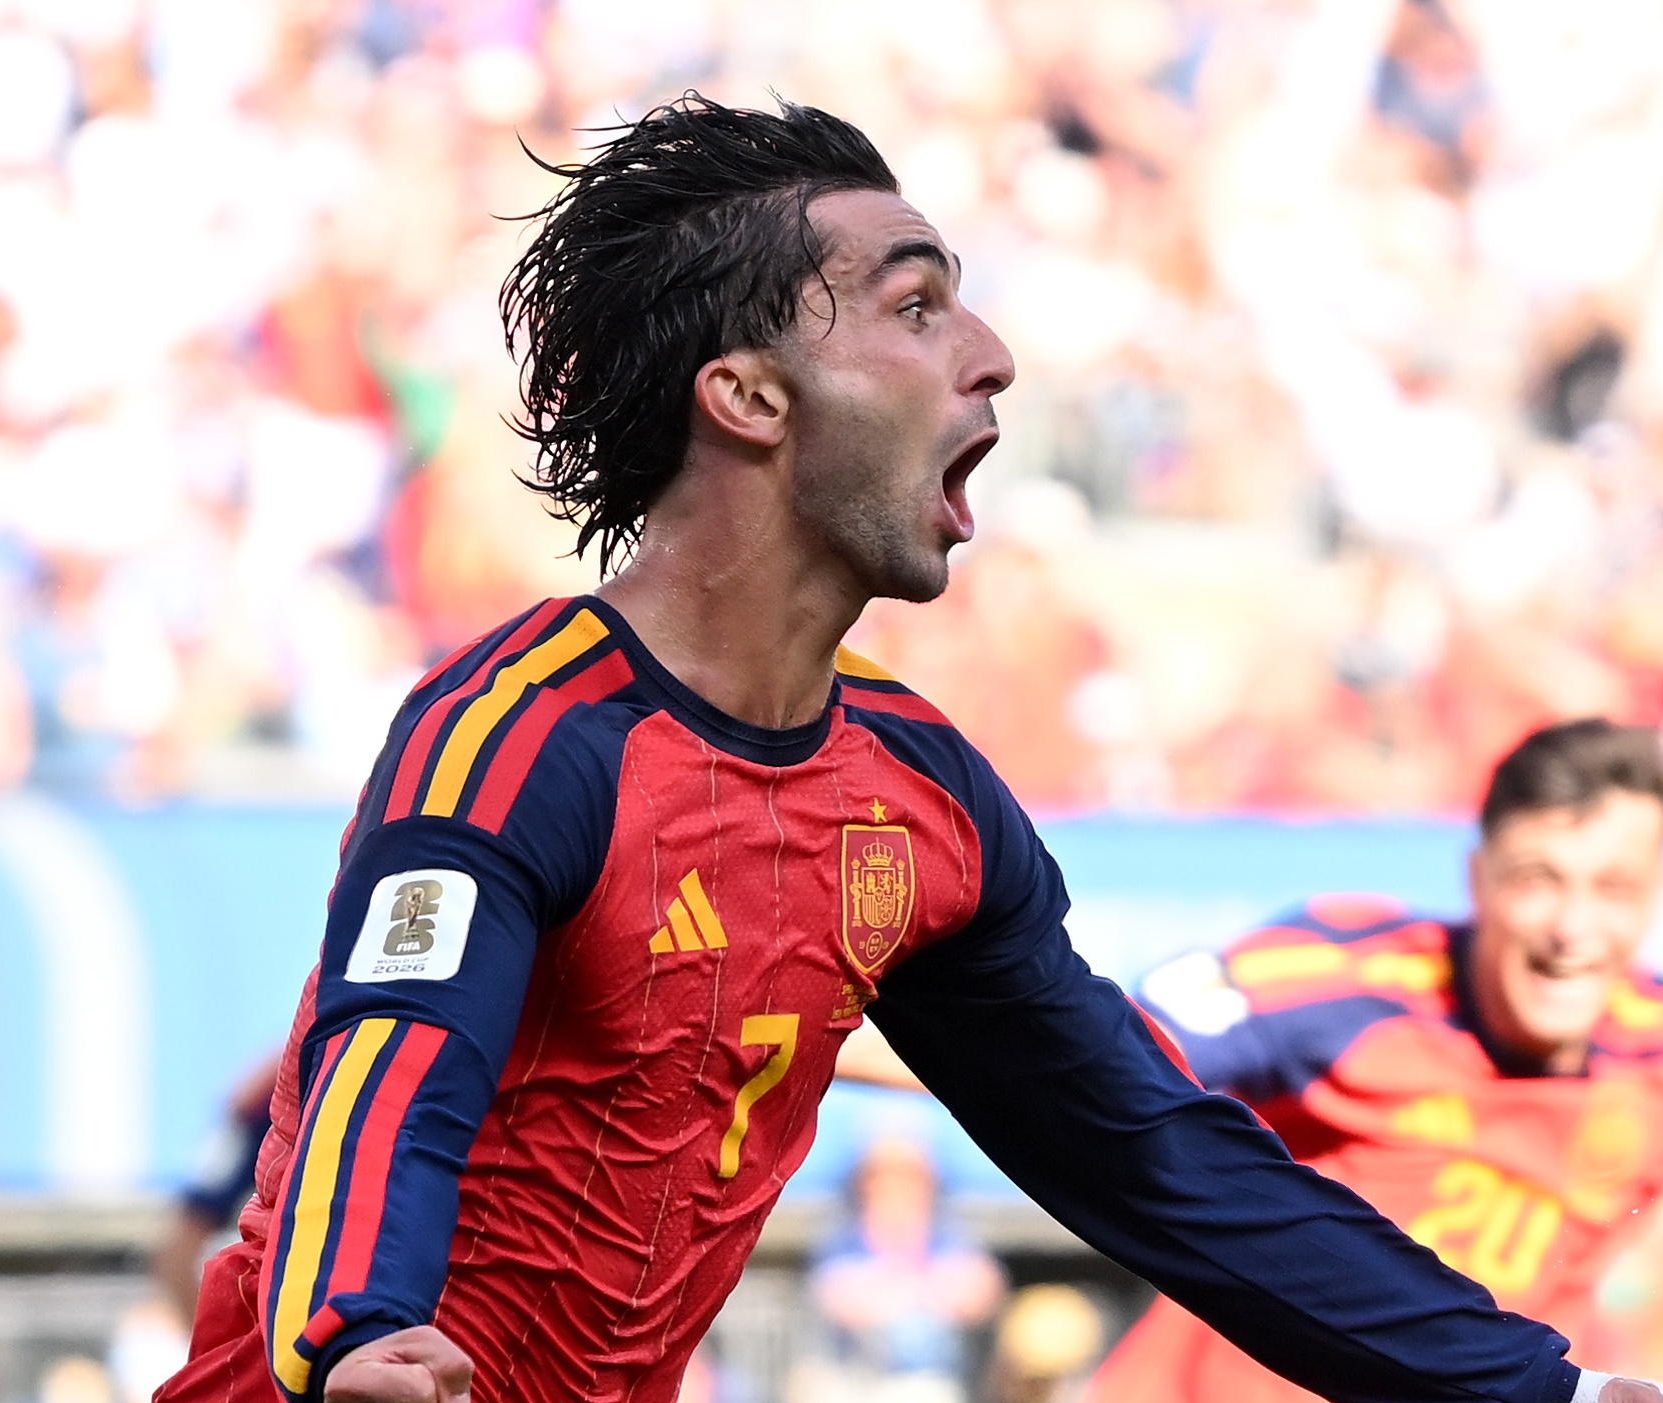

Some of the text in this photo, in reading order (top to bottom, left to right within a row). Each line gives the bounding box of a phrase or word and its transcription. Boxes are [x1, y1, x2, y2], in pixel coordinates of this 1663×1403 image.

[396, 941, 420, 953] FIFA
[372, 963, 426, 974] 2026
[718, 1013, 800, 1179] 7
